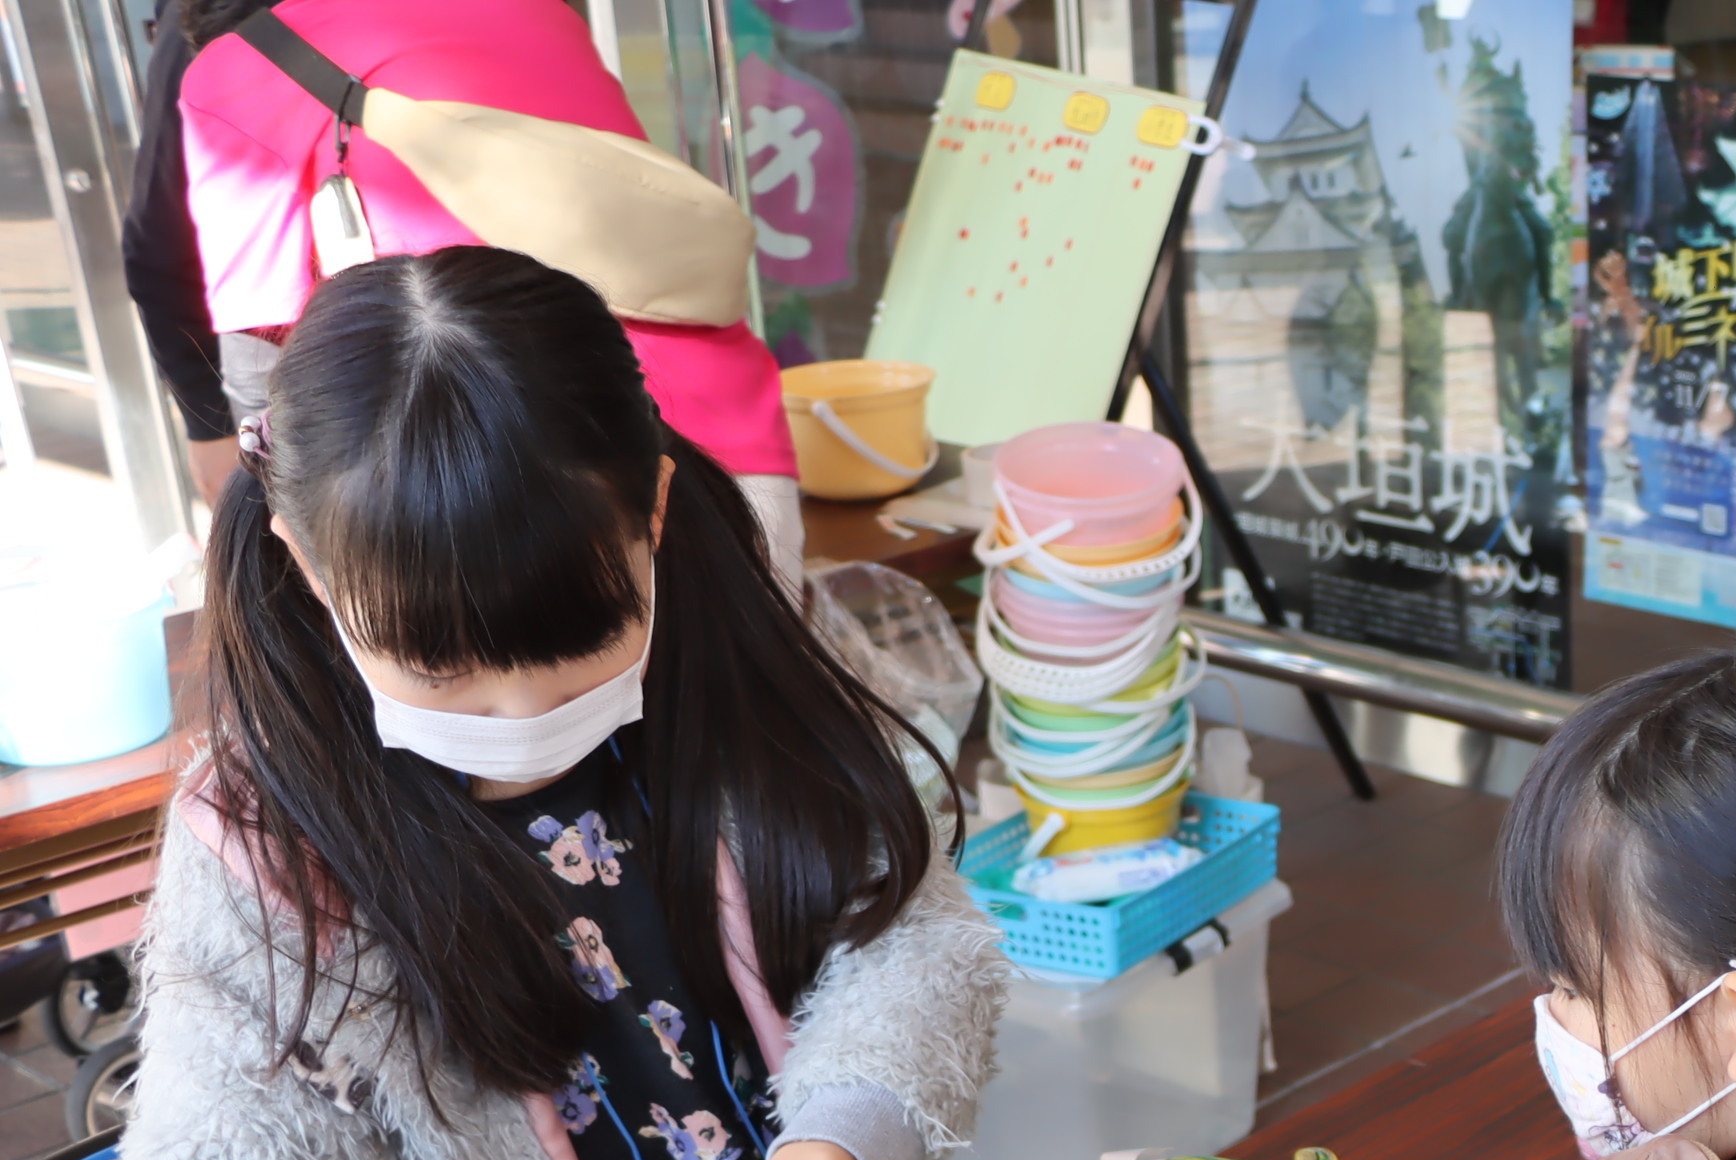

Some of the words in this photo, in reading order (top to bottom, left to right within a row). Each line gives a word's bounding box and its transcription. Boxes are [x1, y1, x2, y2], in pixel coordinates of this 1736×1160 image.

[745, 105, 823, 260] き
[1240, 405, 1534, 555] 大垣城
